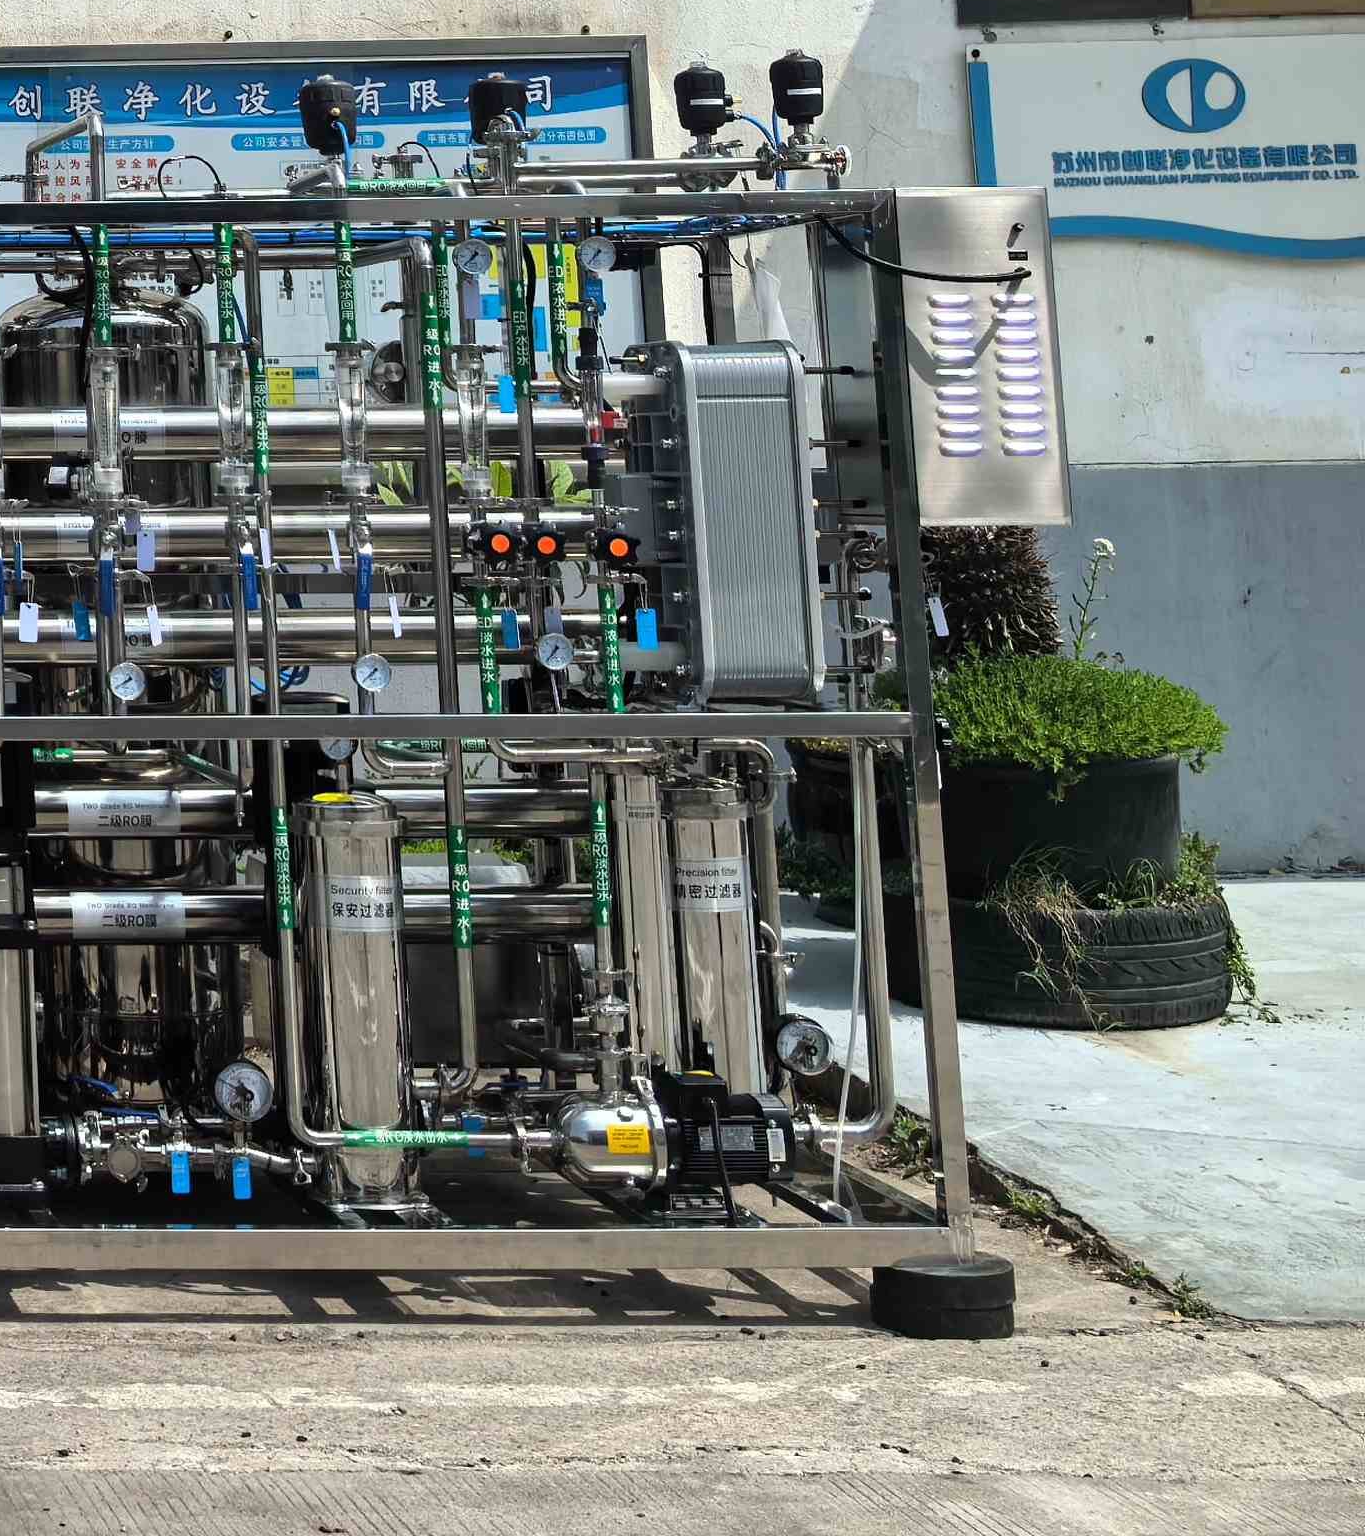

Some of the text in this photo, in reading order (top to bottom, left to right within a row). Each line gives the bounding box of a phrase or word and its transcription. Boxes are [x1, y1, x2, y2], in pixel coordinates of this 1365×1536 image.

[60, 139, 155, 151] 公司生产方针
[1051, 143, 1359, 176] 苏州市创联净化设备有限公司
[1053, 175, 1102, 188] SUZHOU
[1103, 174, 1179, 187] CHUANGLIAN
[97, 814, 153, 828] 二级RO膜
[675, 866, 720, 878] Precision
[331, 901, 395, 919] 保安过滤器
[102, 913, 158, 928] 二级RO膜
